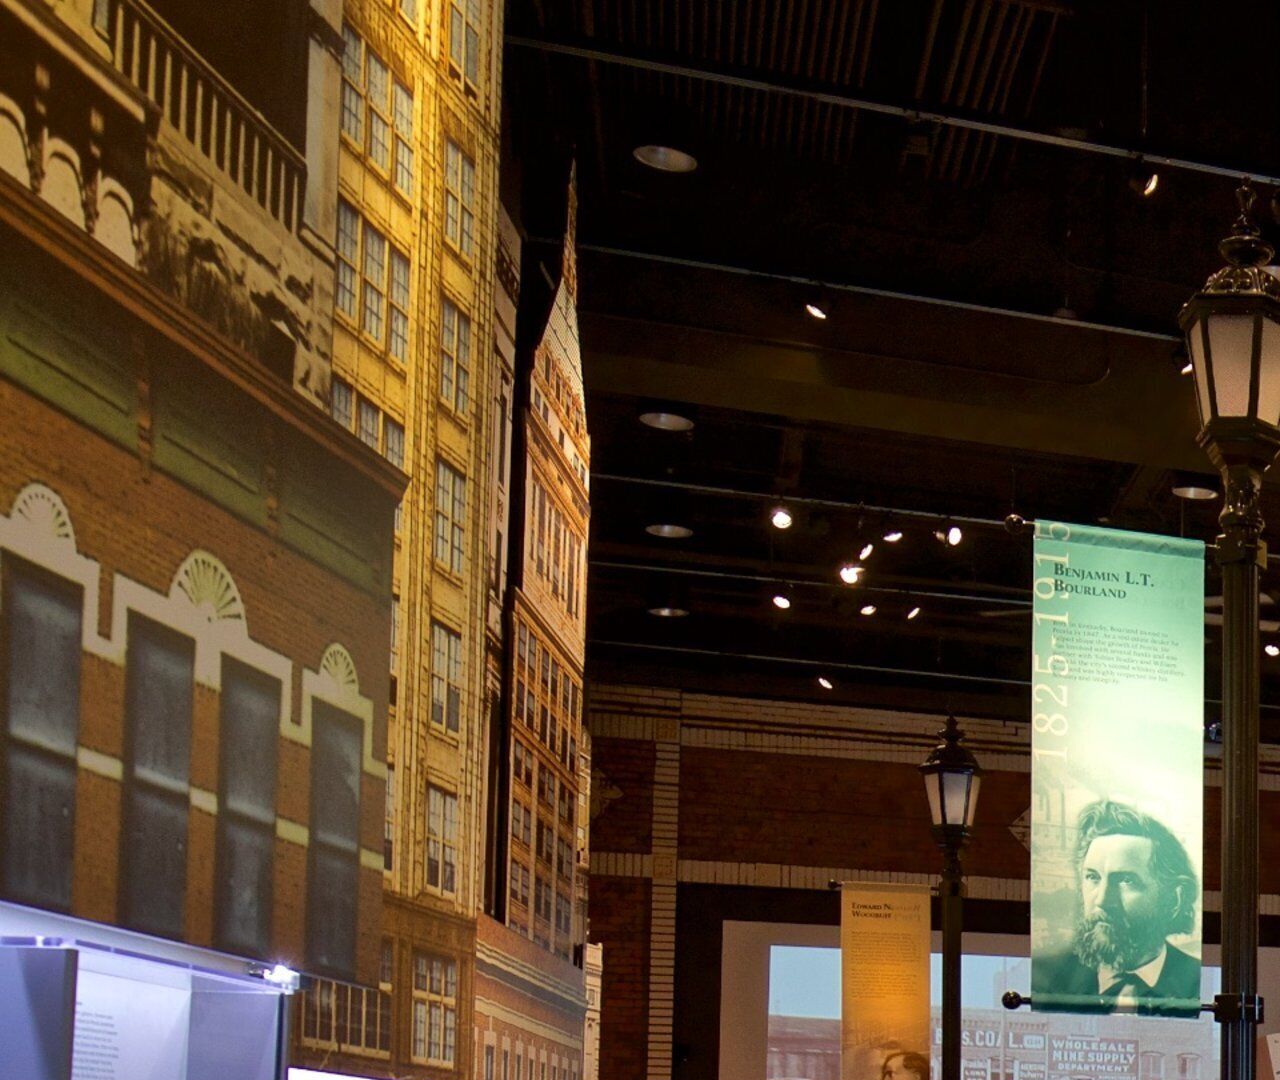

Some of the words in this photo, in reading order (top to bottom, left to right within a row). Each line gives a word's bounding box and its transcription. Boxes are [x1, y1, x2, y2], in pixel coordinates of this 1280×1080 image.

[1054, 562, 1120, 582] BENJAMIN
[1125, 571, 1155, 588] L.T.
[1053, 579, 1127, 599] BOURLAND
[1052, 1039, 1135, 1053] WHOLESALE
[1052, 1050, 1086, 1062] MINE
[1087, 1051, 1137, 1065] SUPPLY
[1057, 1062, 1130, 1073] DEPARTMENT
